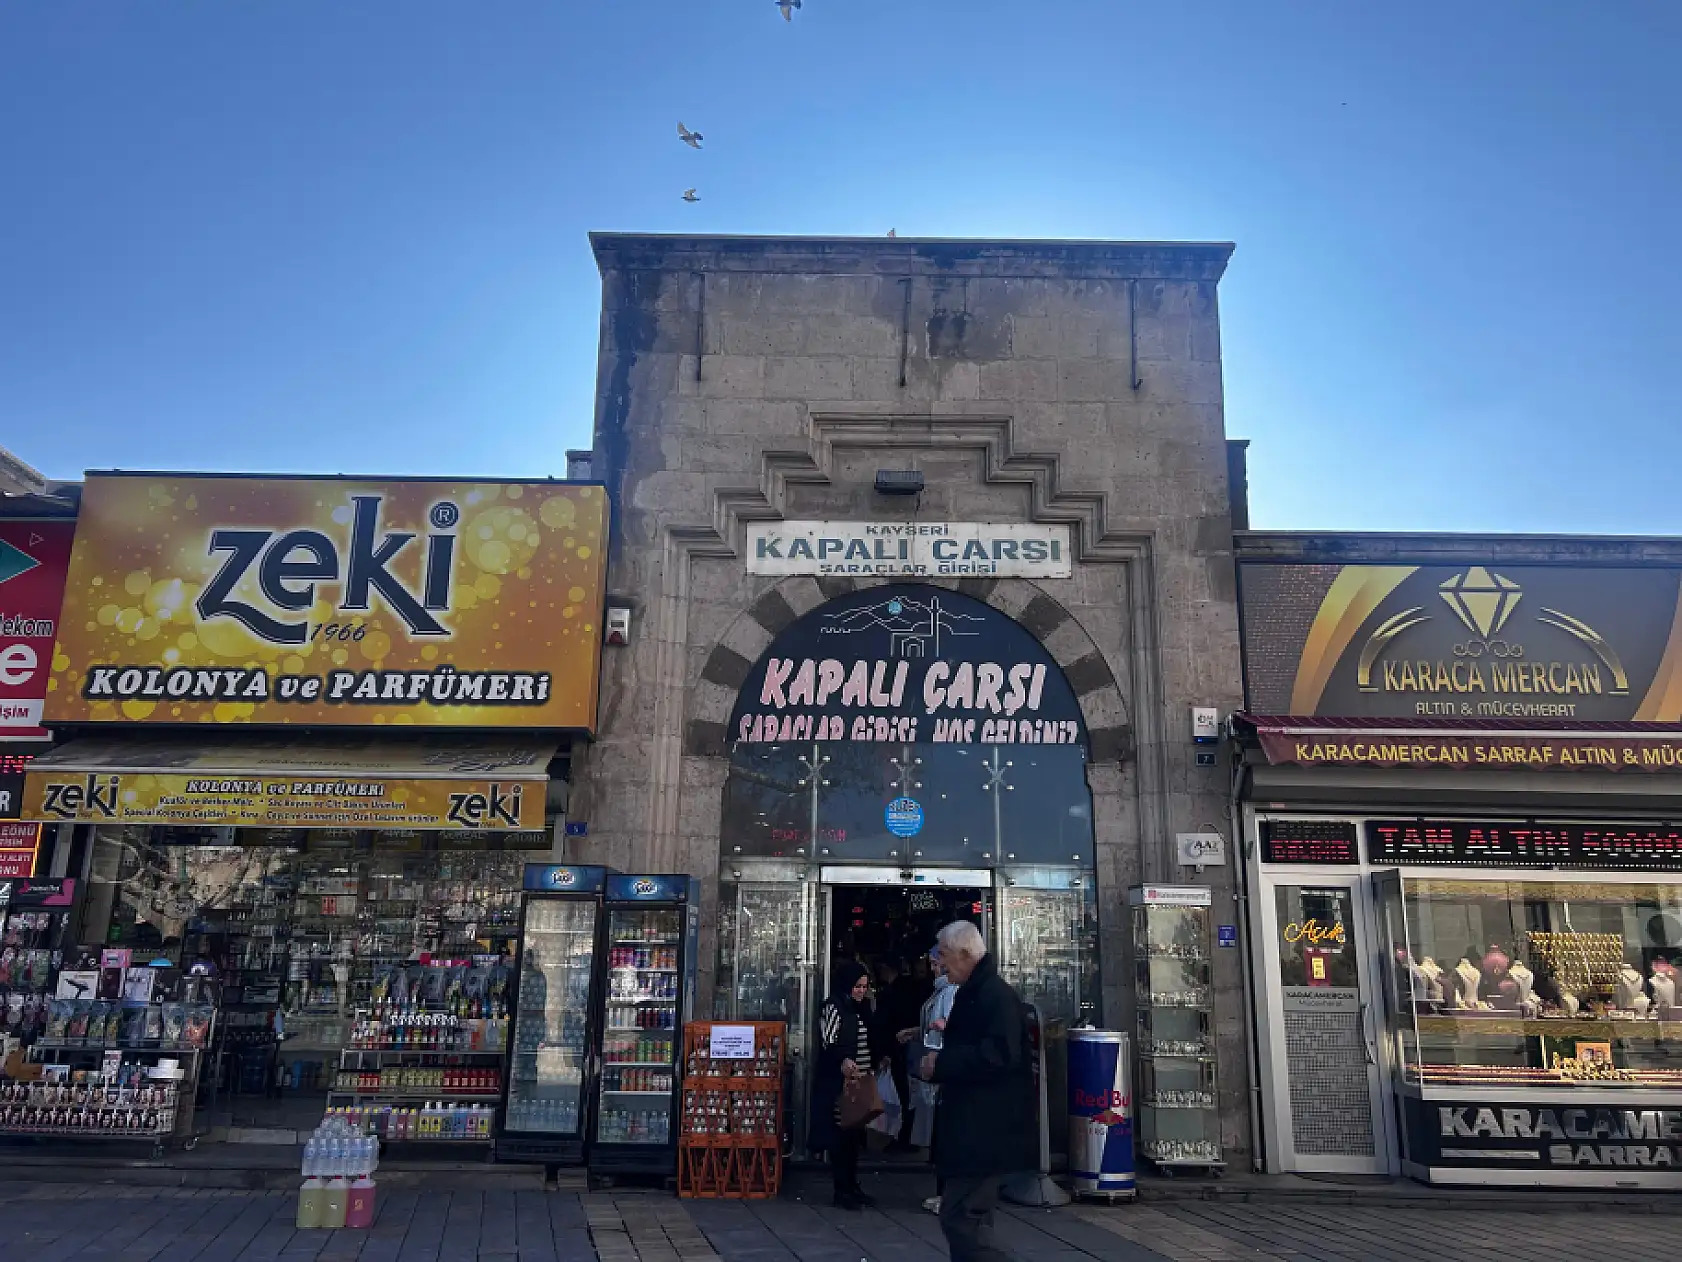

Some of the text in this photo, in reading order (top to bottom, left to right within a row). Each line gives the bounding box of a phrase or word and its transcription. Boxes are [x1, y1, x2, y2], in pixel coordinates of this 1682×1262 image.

[866, 524, 949, 537] KAYSERİ
[756, 537, 908, 560] KAPALI
[311, 623, 366, 642] 1966
[89, 667, 267, 697] KOLONYA
[279, 676, 319, 699] ve
[759, 658, 1047, 717] KAPALI ÇARŞI
[1384, 660, 1602, 694] KARACA MERCAN
[1296, 743, 1469, 763] KARACAMERCAN
[1475, 745, 1553, 764] SARRAF
[1560, 747, 1615, 764] ALTIN
[1622, 748, 1638, 764] &
[43, 774, 120, 818] zeki
[186, 780, 262, 794] KOLONYA
[447, 783, 523, 827] zeki
[1377, 827, 1454, 855] TAM
[1465, 829, 1572, 857] ALTIN
[1284, 918, 1346, 944] Açık
[1074, 1088, 1109, 1107] Red
